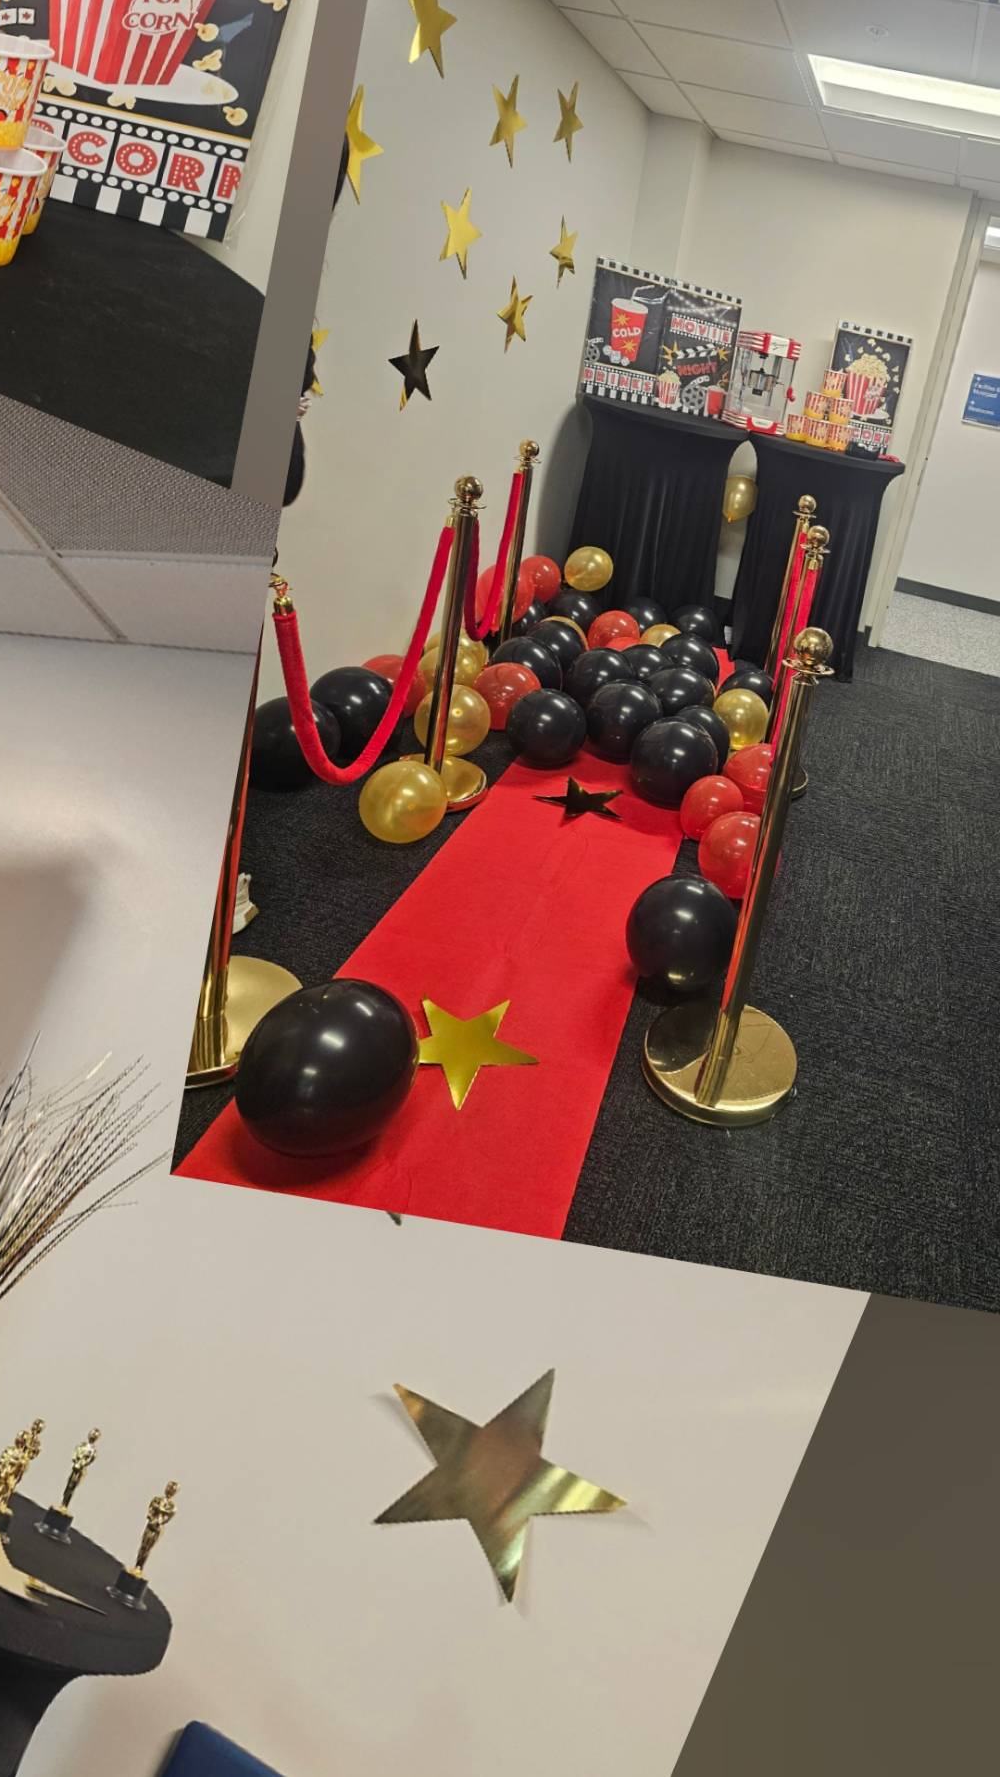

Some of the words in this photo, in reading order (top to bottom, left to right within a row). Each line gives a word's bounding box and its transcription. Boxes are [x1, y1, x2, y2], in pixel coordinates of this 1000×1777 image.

[123, 11, 195, 32] CORN
[611, 326, 642, 338] COLD
[670, 317, 734, 344] MOVIE
[675, 361, 719, 376] NIGHT
[583, 367, 655, 394] DRINKS
